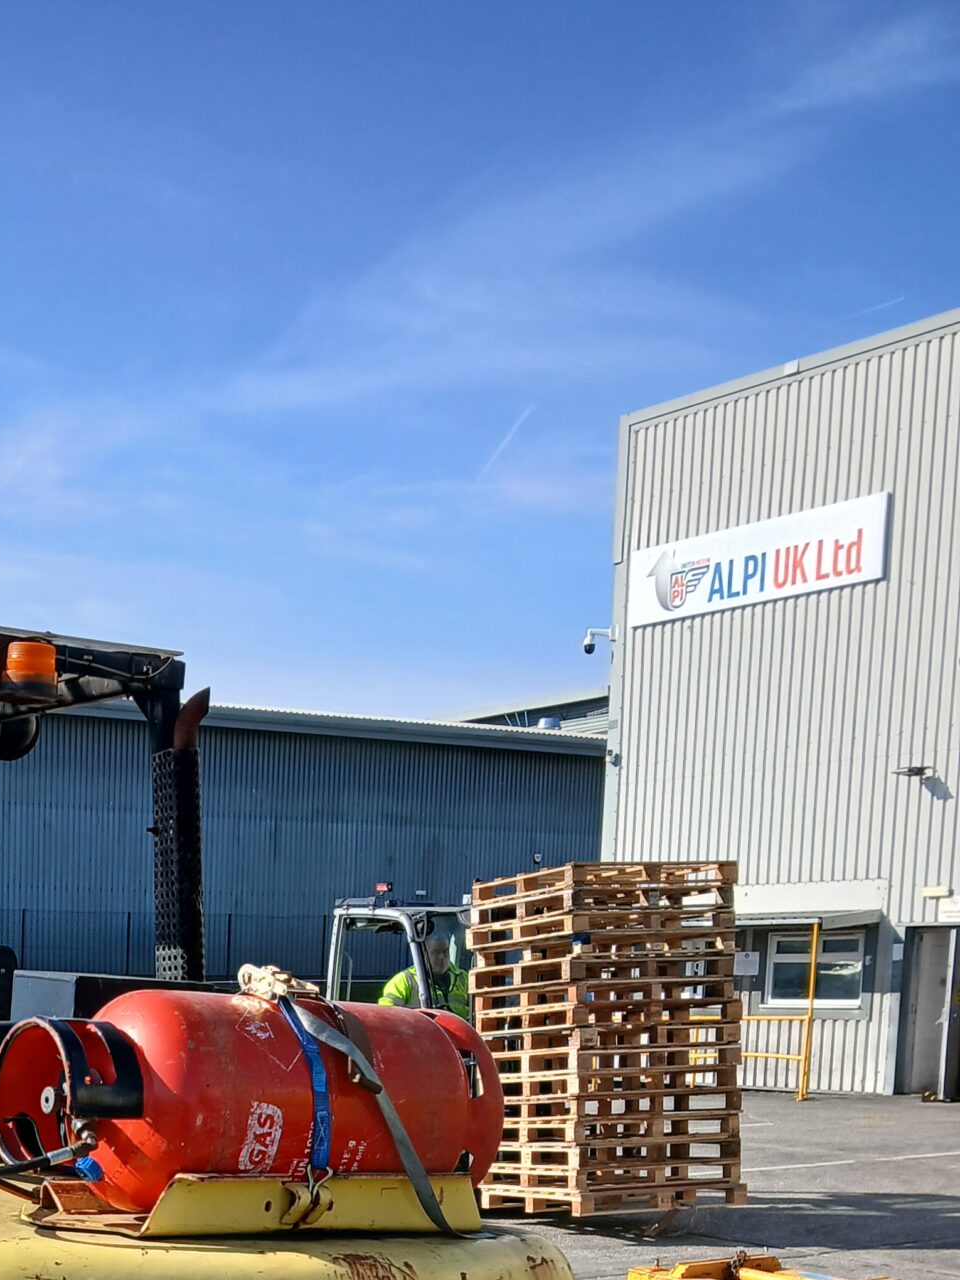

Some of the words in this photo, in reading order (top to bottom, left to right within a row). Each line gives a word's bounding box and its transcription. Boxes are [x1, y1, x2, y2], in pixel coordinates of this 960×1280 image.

[672, 574, 686, 589] AL
[707, 552, 767, 603] ALPI
[773, 541, 811, 589] UK
[815, 528, 863, 581] Ltd
[671, 588, 684, 603] PI
[248, 1111, 277, 1165] GAS
